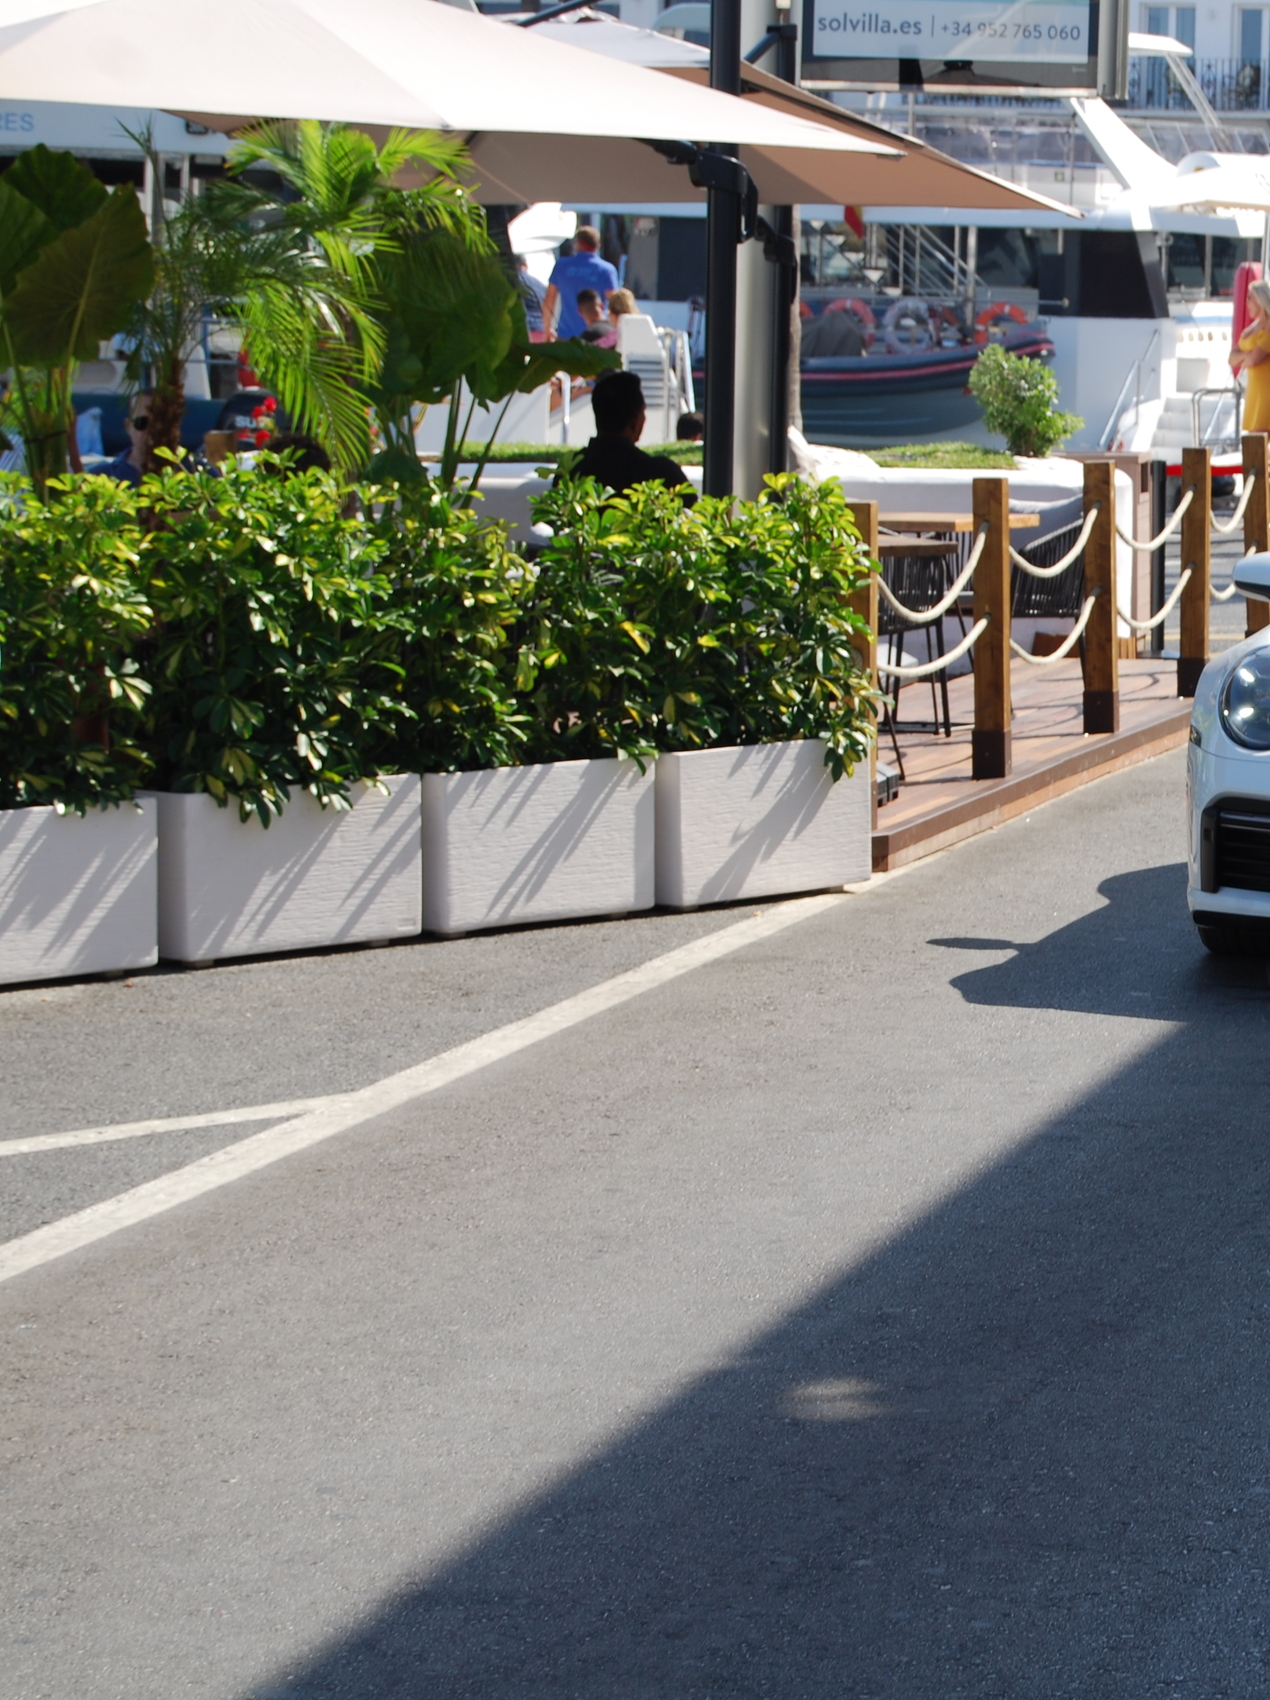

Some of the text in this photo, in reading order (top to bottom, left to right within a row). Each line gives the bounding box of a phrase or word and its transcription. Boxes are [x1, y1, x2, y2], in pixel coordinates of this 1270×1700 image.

[818, 12, 1081, 41] solvilla.es +34 952 765 060
[0, 112, 35, 132] ES
